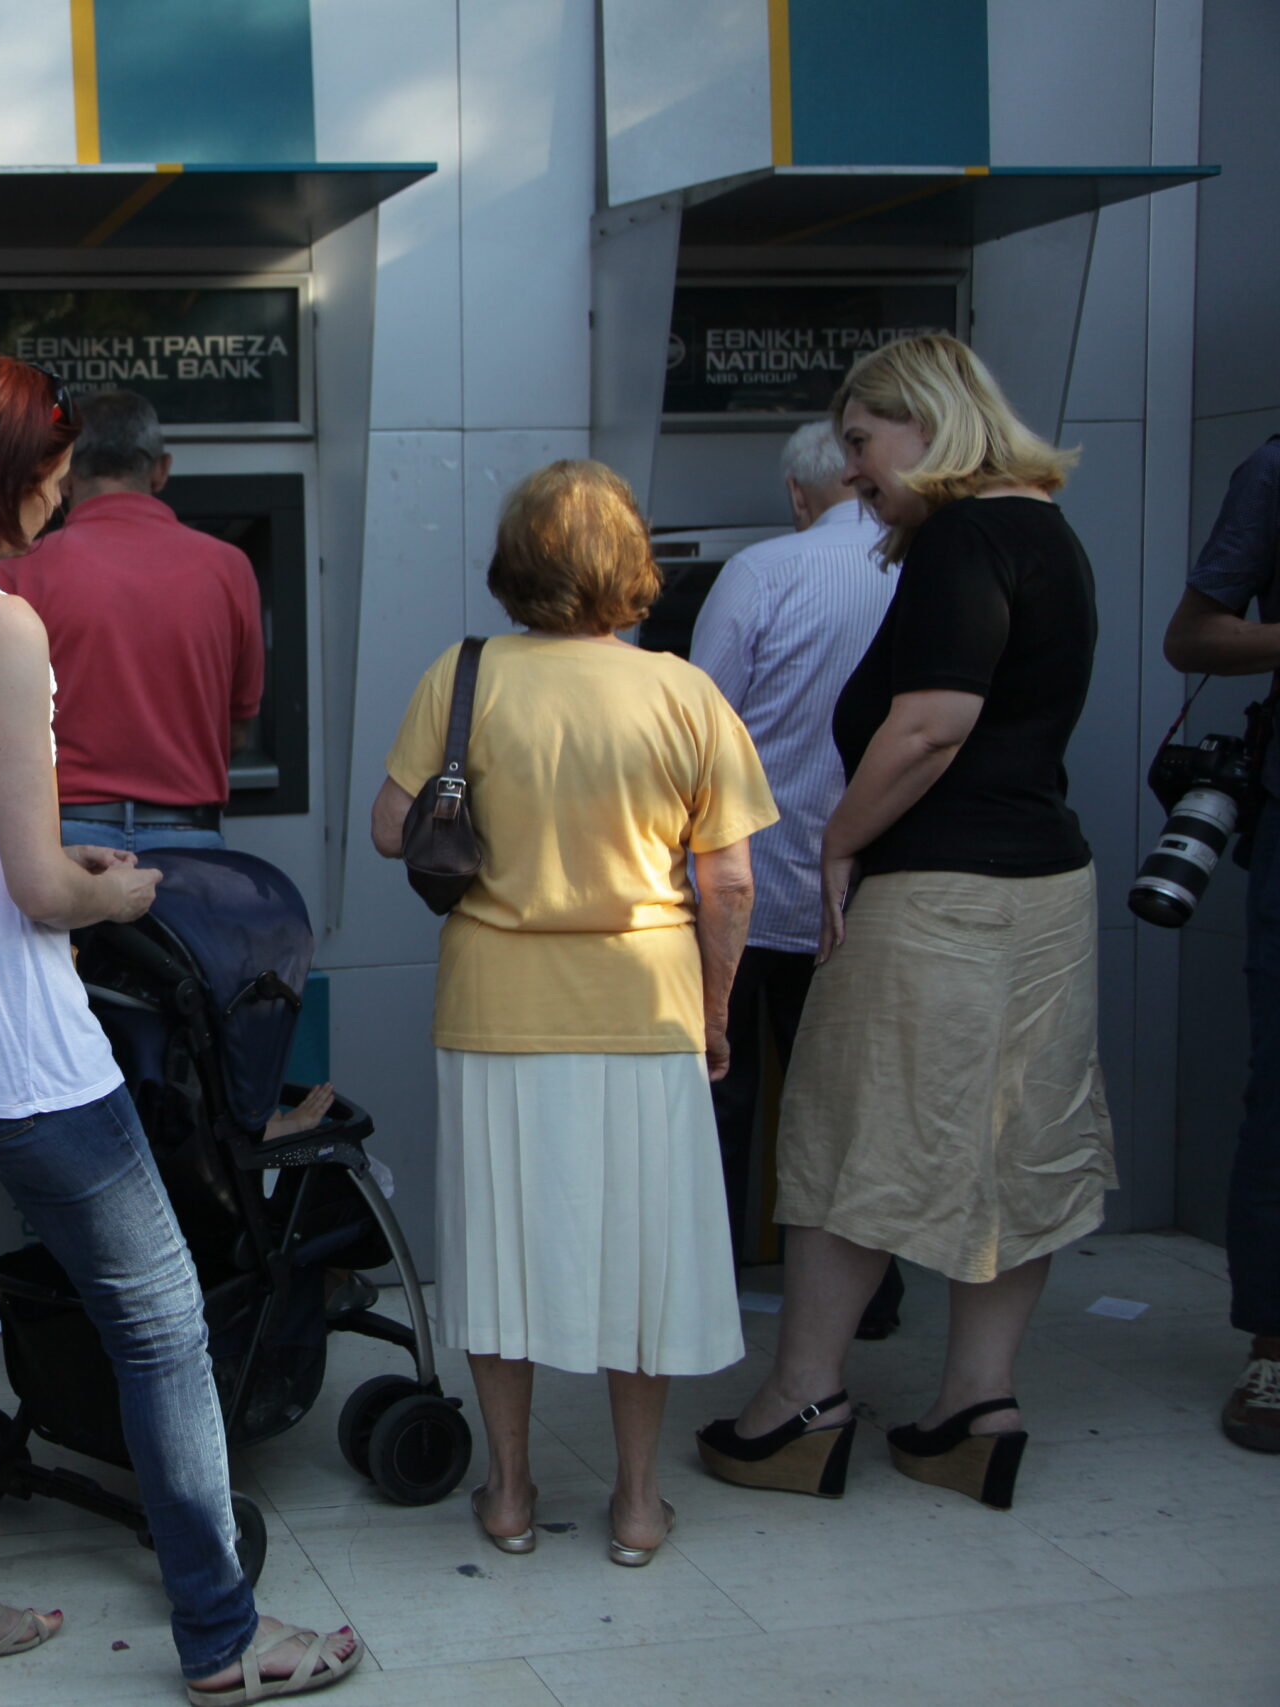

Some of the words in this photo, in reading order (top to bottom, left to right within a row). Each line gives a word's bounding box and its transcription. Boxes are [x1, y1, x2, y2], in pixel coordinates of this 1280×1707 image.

[16, 336, 133, 358] ΕΘΝΙΚΗ
[143, 336, 288, 357] ΤΡΑΠΕΖΑ
[705, 328, 814, 349] ΕΘΝΙΚΗ
[37, 358, 168, 380] ATIONAL
[177, 358, 263, 379] BANK
[705, 350, 845, 370] NATIONAL
[706, 372, 738, 384] NBG
[742, 371, 799, 384] GROUP
